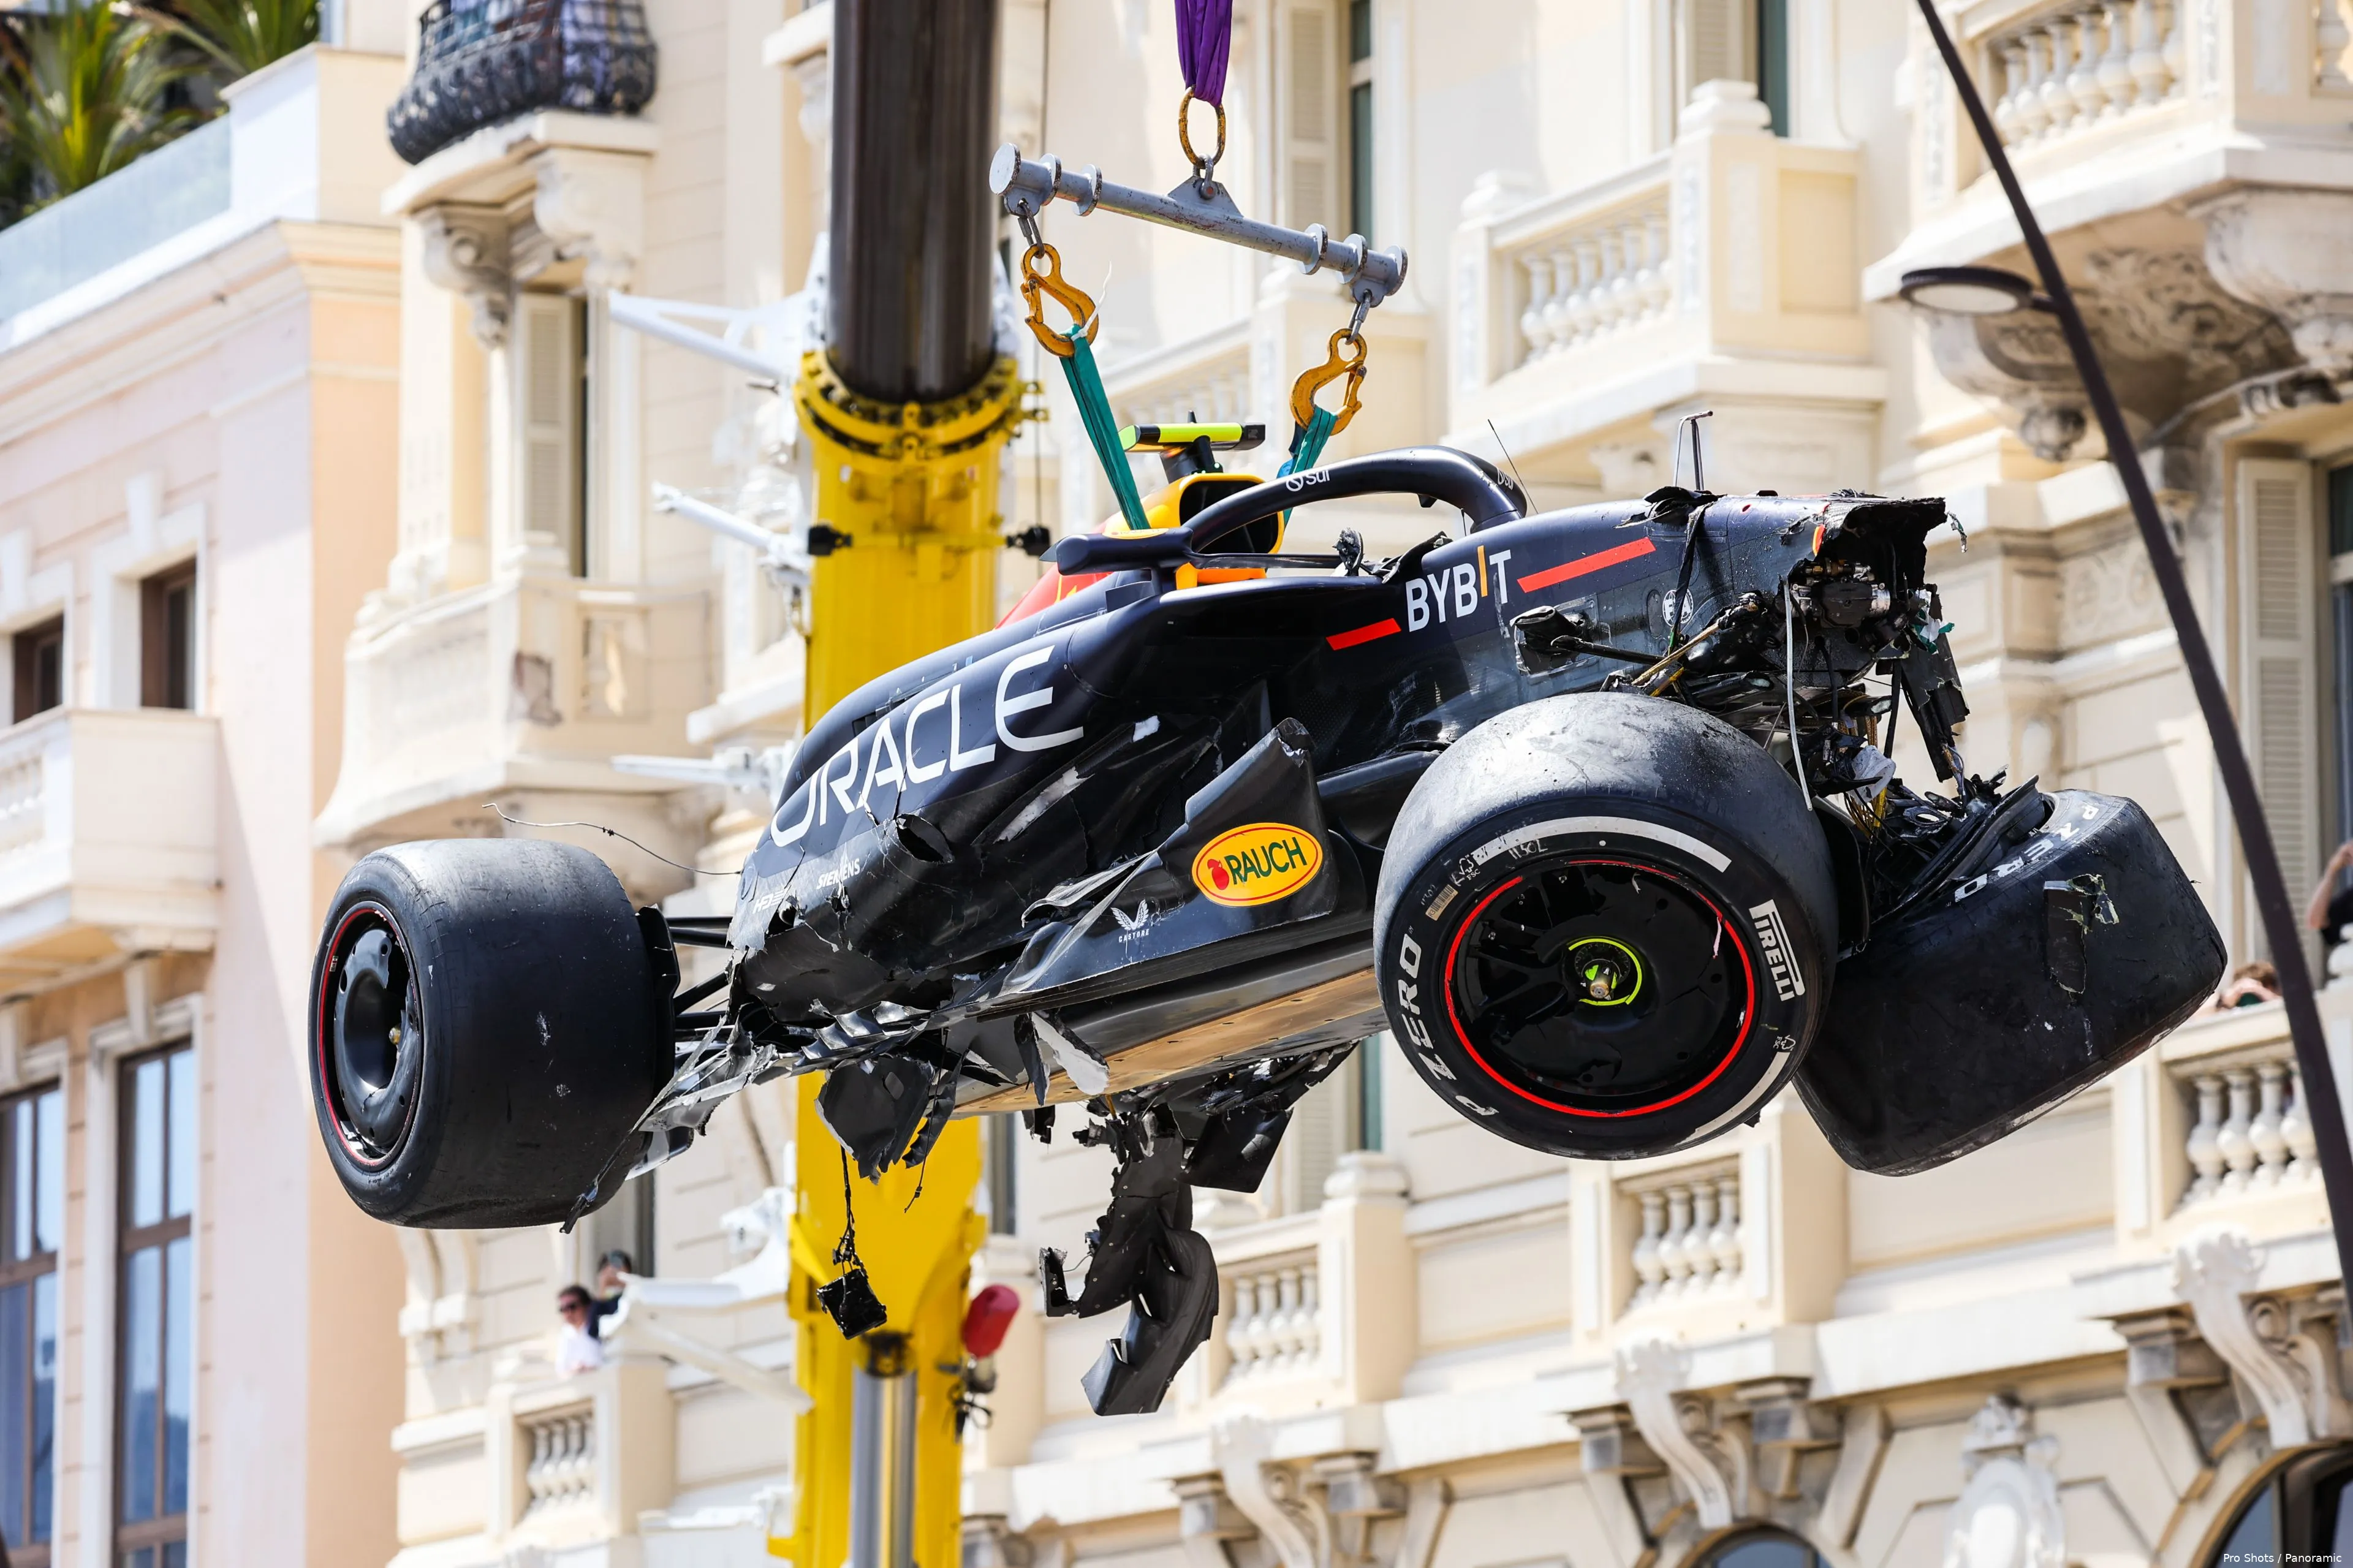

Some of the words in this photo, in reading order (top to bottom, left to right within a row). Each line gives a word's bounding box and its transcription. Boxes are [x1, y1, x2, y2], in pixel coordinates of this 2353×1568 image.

[1406, 545, 1512, 632] BYBIT
[770, 645, 1084, 847] ORACLE
[816, 858, 860, 890] SIEMENS
[1224, 836, 1308, 885] RAUCH
[1466, 868, 1481, 881] FSC
[1118, 929, 1150, 943] CASTORE
[1748, 899, 1806, 1002] PIRELLI
[1398, 933, 1457, 1081] ZERO
